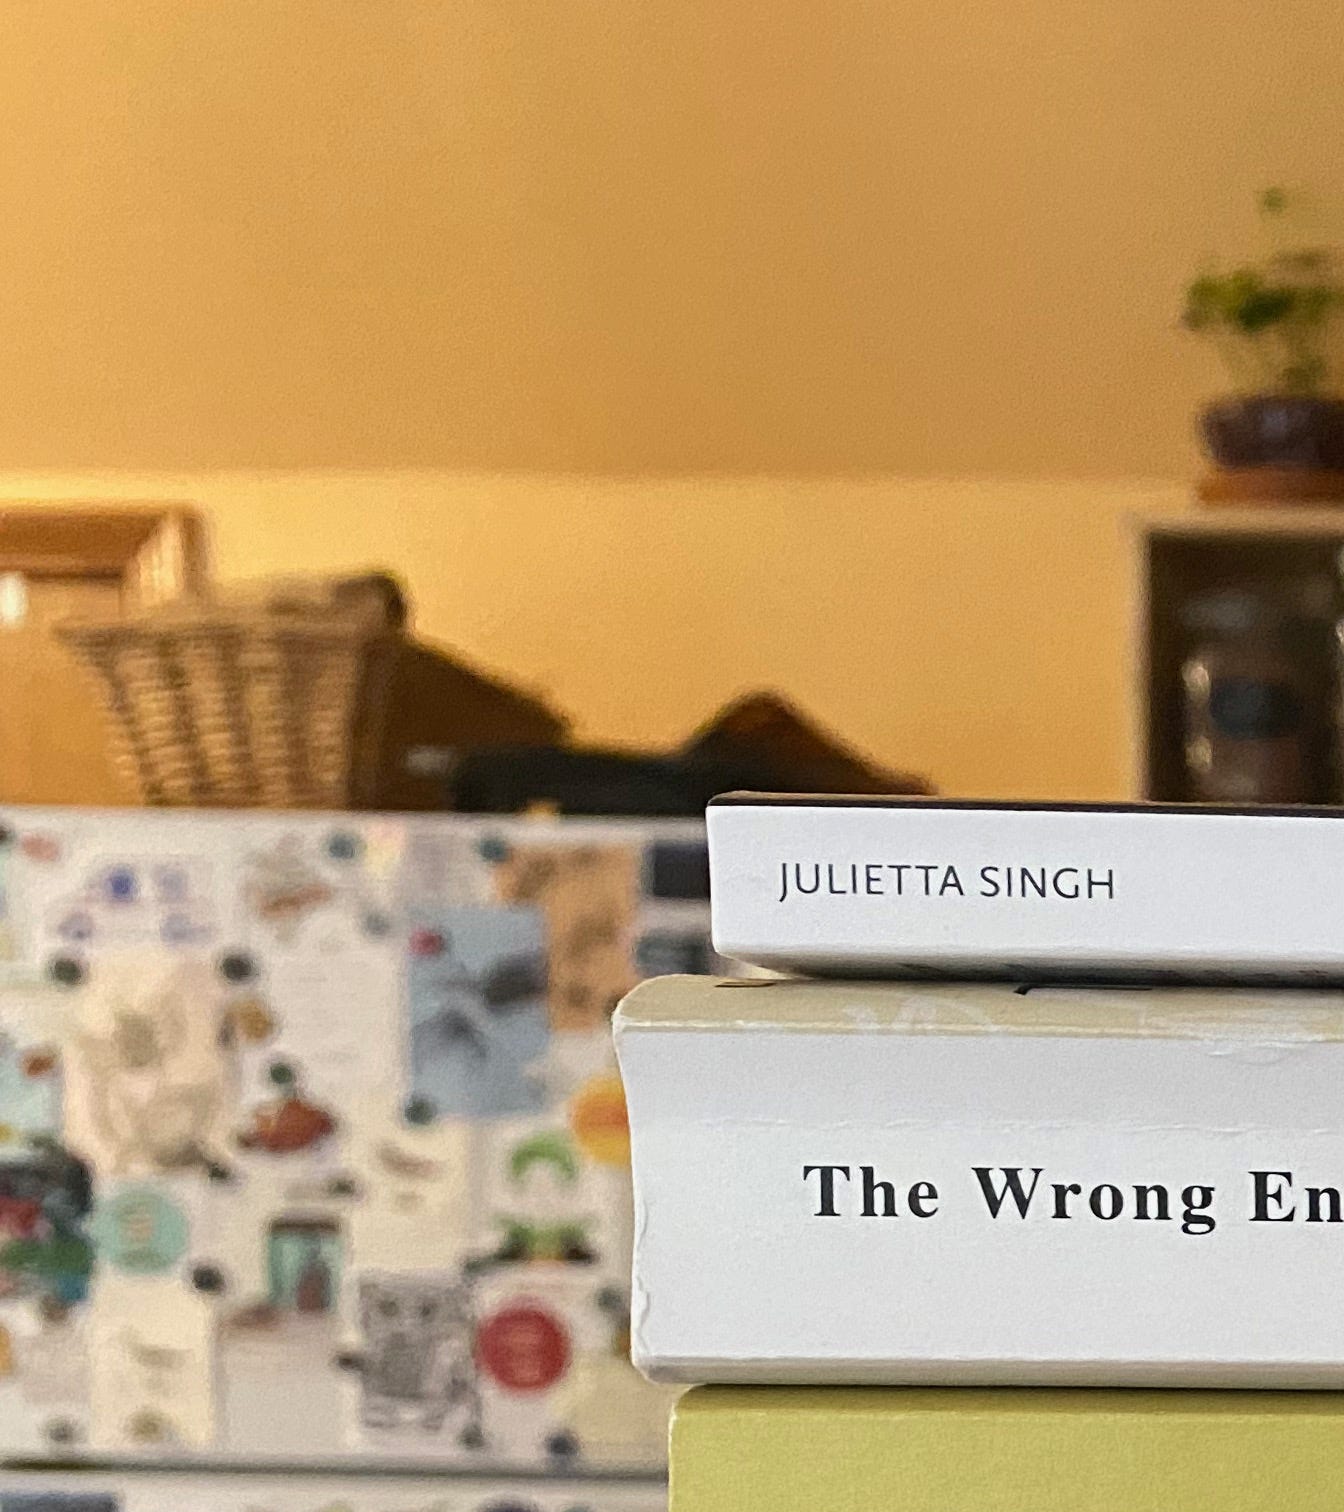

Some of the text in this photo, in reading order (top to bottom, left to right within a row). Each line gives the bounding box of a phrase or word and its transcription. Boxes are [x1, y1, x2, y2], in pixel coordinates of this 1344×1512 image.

[778, 862, 1114, 903] JULIETTA SINGH
[803, 1165, 939, 1219] The
[970, 1167, 1217, 1236] Wrong
